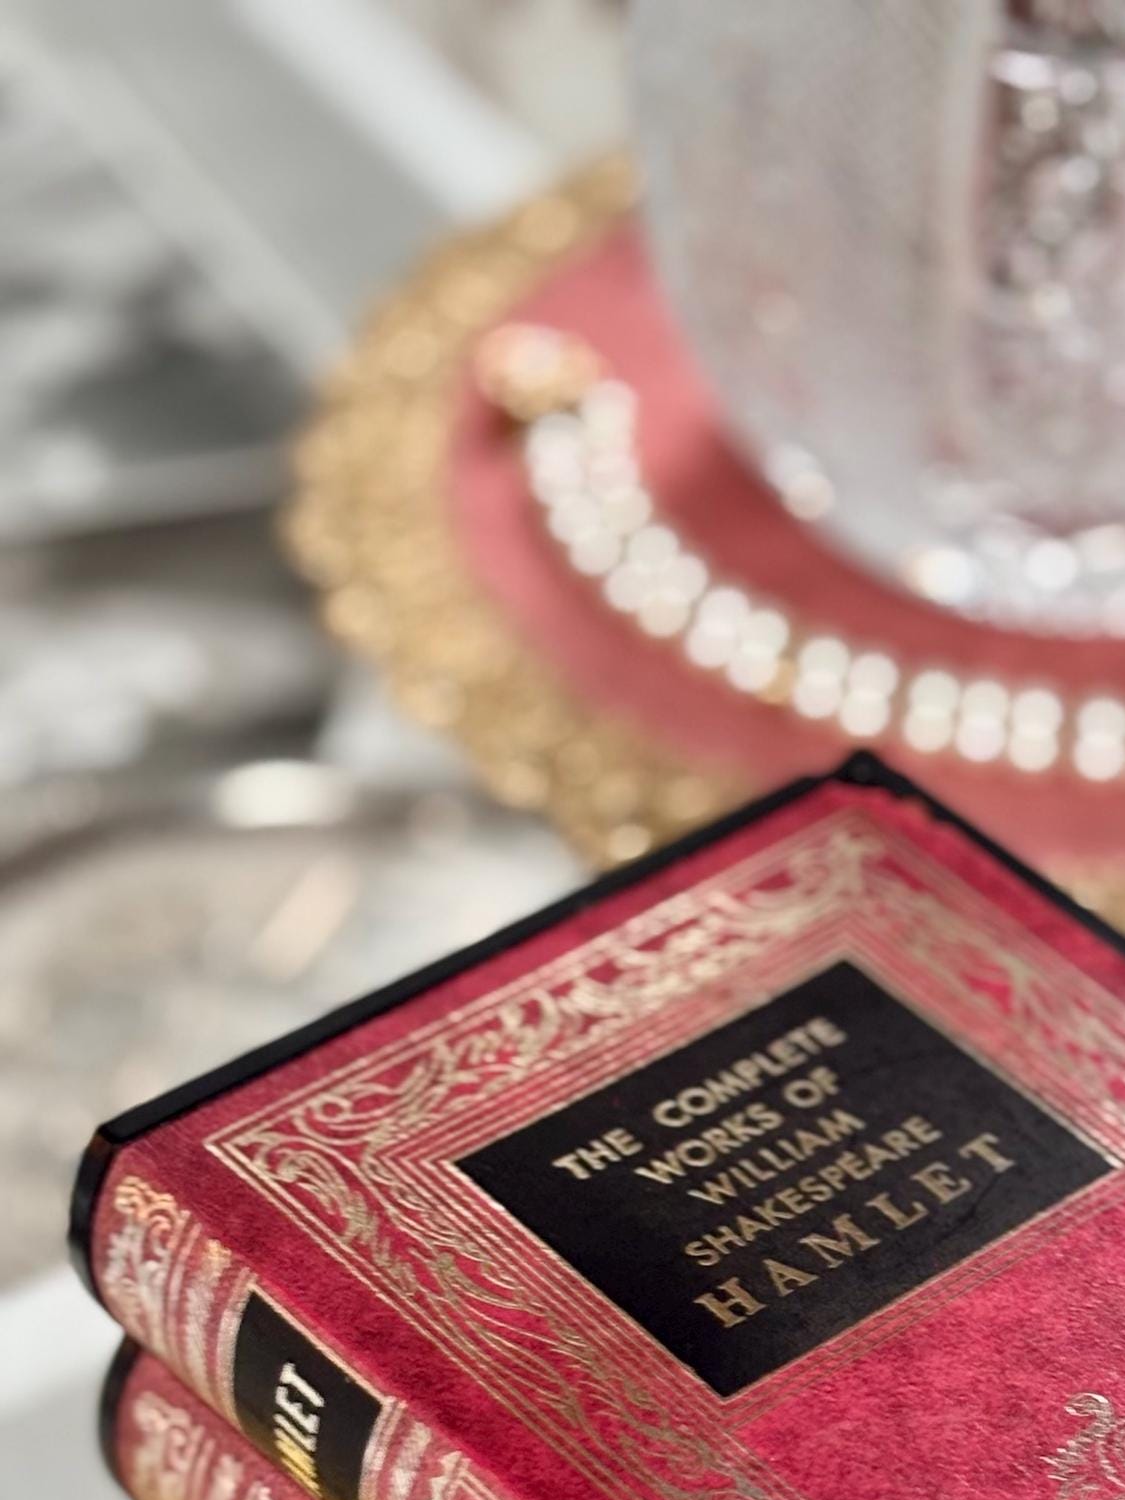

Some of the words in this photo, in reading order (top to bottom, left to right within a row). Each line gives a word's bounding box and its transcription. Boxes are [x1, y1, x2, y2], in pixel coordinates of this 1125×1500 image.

[551, 1128, 644, 1180] THE
[653, 1016, 847, 1128] COMPLETE
[634, 1103, 784, 1184] WORKS
[783, 1066, 840, 1109] OF
[687, 1108, 867, 1206] WILLIAM
[685, 1115, 944, 1267] SHAKESPEARE
[693, 1131, 1016, 1328] HAMLET
